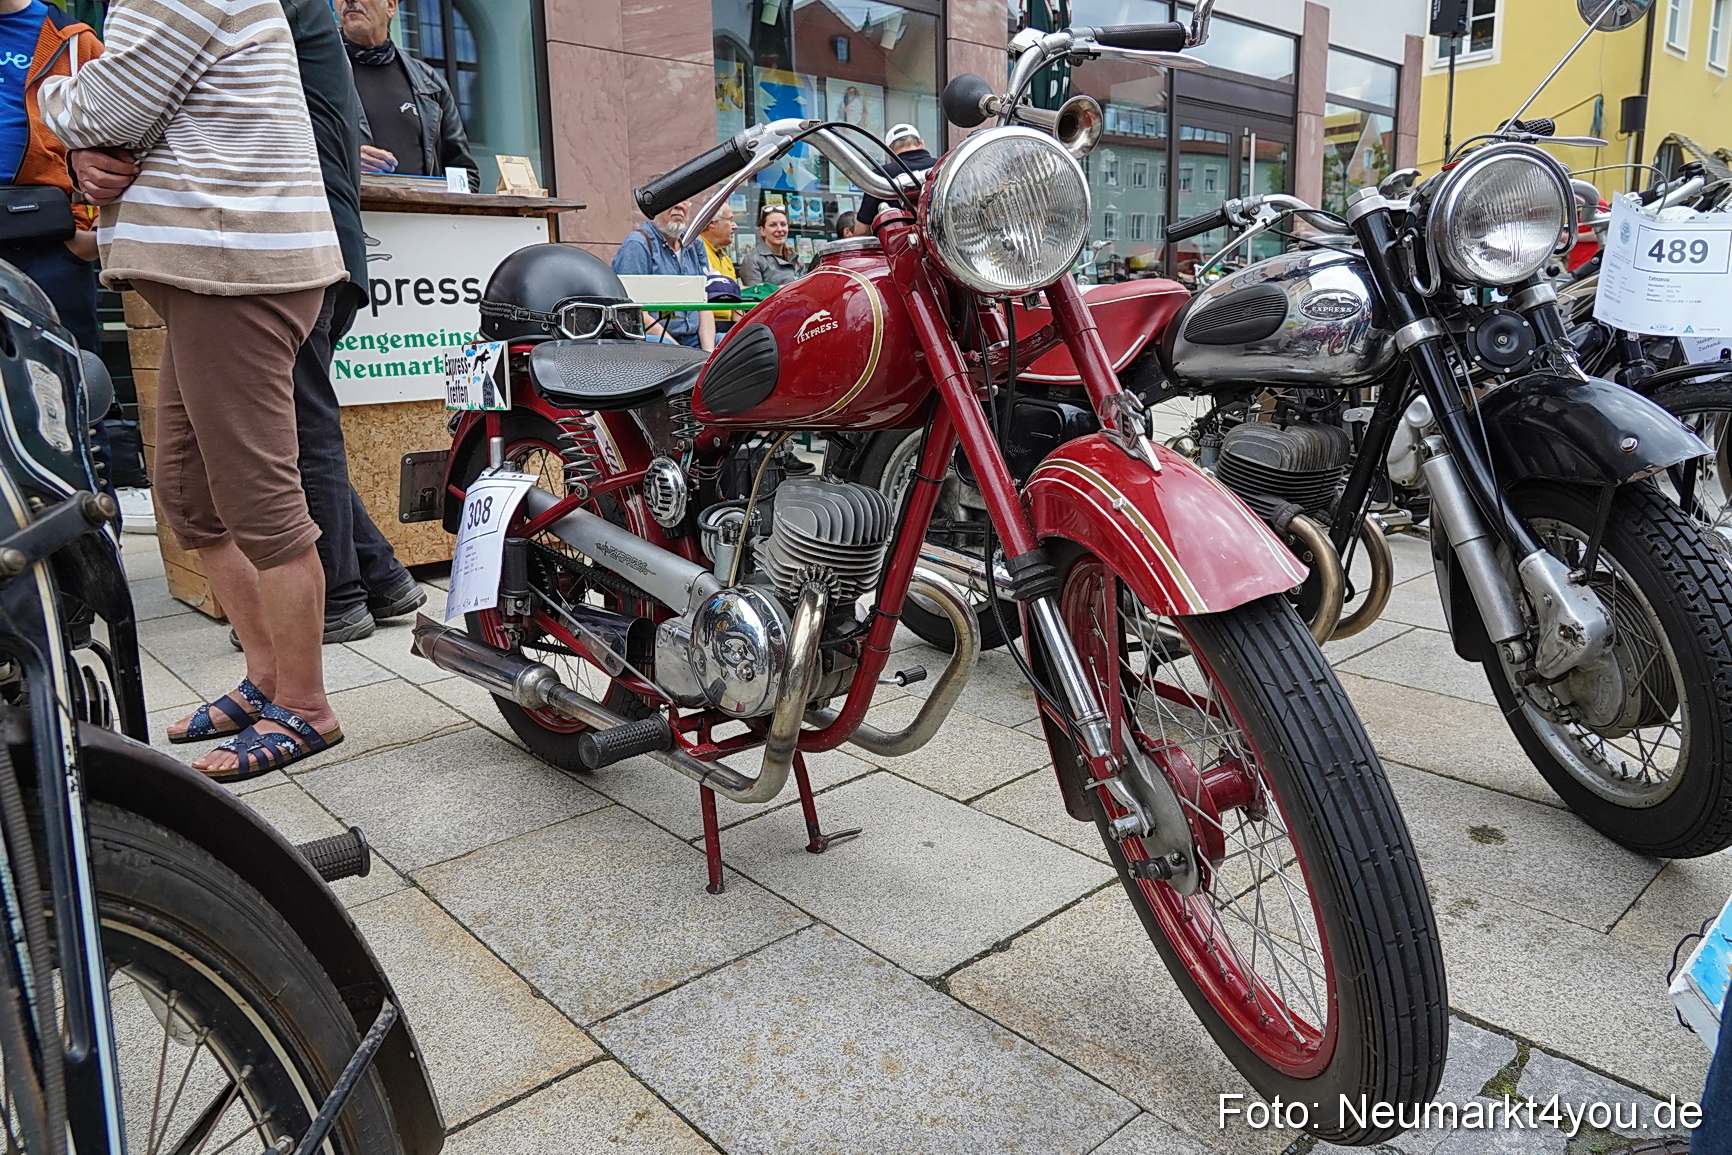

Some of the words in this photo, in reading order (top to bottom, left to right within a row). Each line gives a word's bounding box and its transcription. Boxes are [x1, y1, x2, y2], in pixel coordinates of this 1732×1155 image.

[1648, 239, 1709, 264] 489
[369, 277, 482, 317] press
[800, 321, 839, 343] EXPRESS
[444, 353, 471, 382] Express-
[446, 380, 469, 404] Treffen
[467, 495, 493, 530] 308
